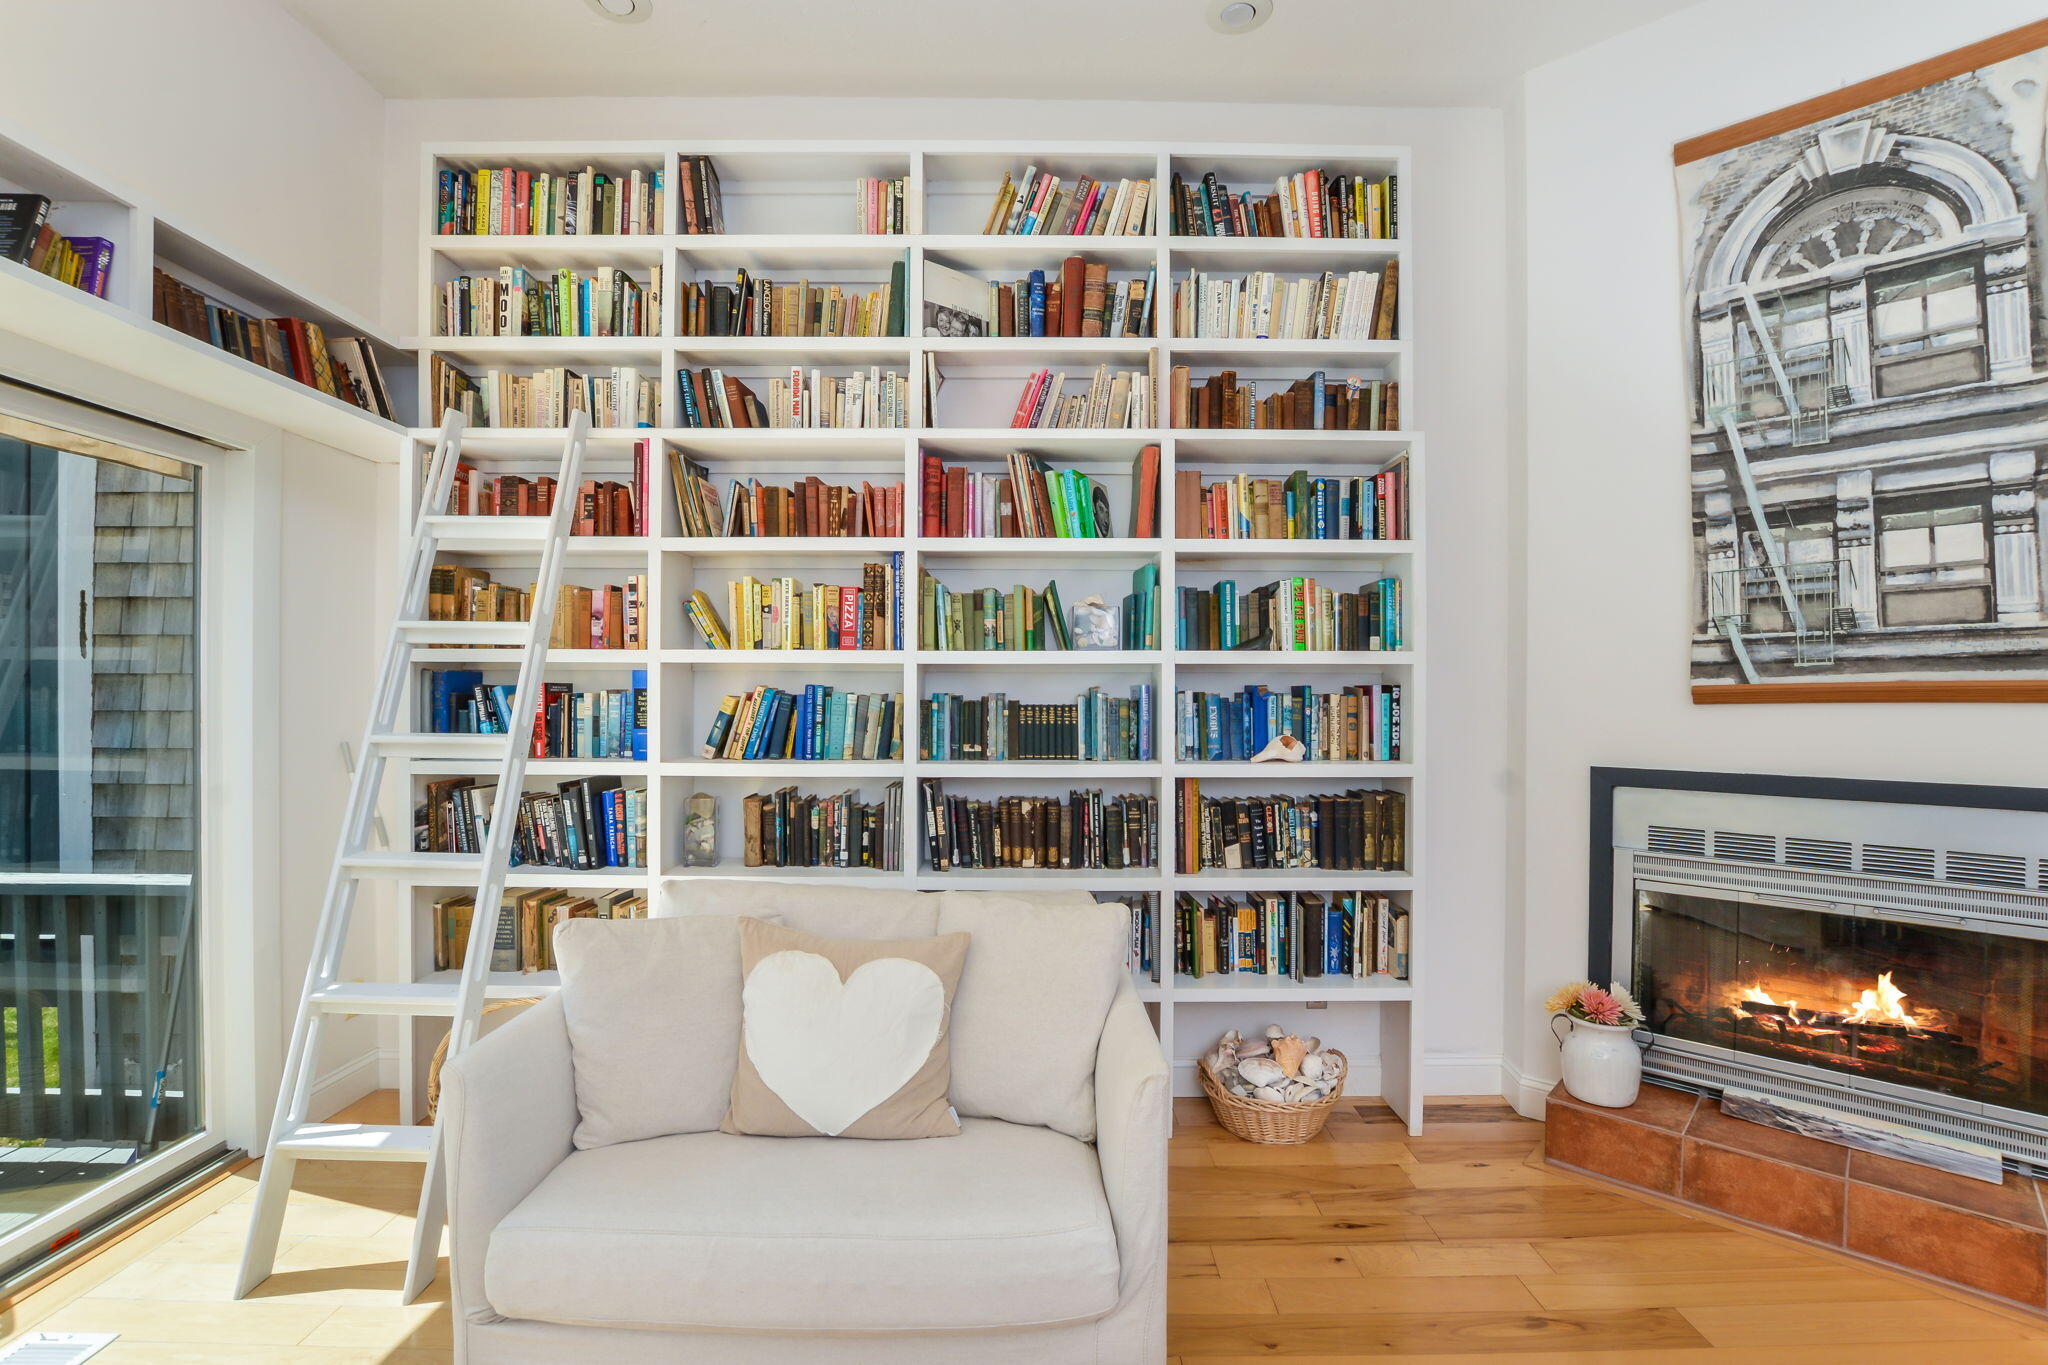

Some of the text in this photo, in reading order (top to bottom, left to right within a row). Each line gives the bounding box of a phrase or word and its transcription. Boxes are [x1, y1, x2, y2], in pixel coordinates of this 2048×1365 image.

[1208, 176, 1219, 206] PURSUIT
[1312, 192, 1320, 214] DOING
[500, 283, 510, 328] MOO
[680, 370, 693, 415] DENNIS LEHANE
[792, 370, 800, 416] FLORIDA MAN
[844, 594, 854, 628] PIZZA
[1295, 586, 1304, 602] CUE
[1295, 605, 1304, 620] THE
[476, 686, 488, 720] LAURA LIPPMAN
[1392, 688, 1400, 746] IQ JOE IDE
[750, 700, 768, 742] THIRTEEN DAYS
[1210, 706, 1218, 740] EXODUS
[616, 804, 624, 821] COSBY
[936, 806, 946, 834] Baseball
[1266, 806, 1274, 832] CLEON
